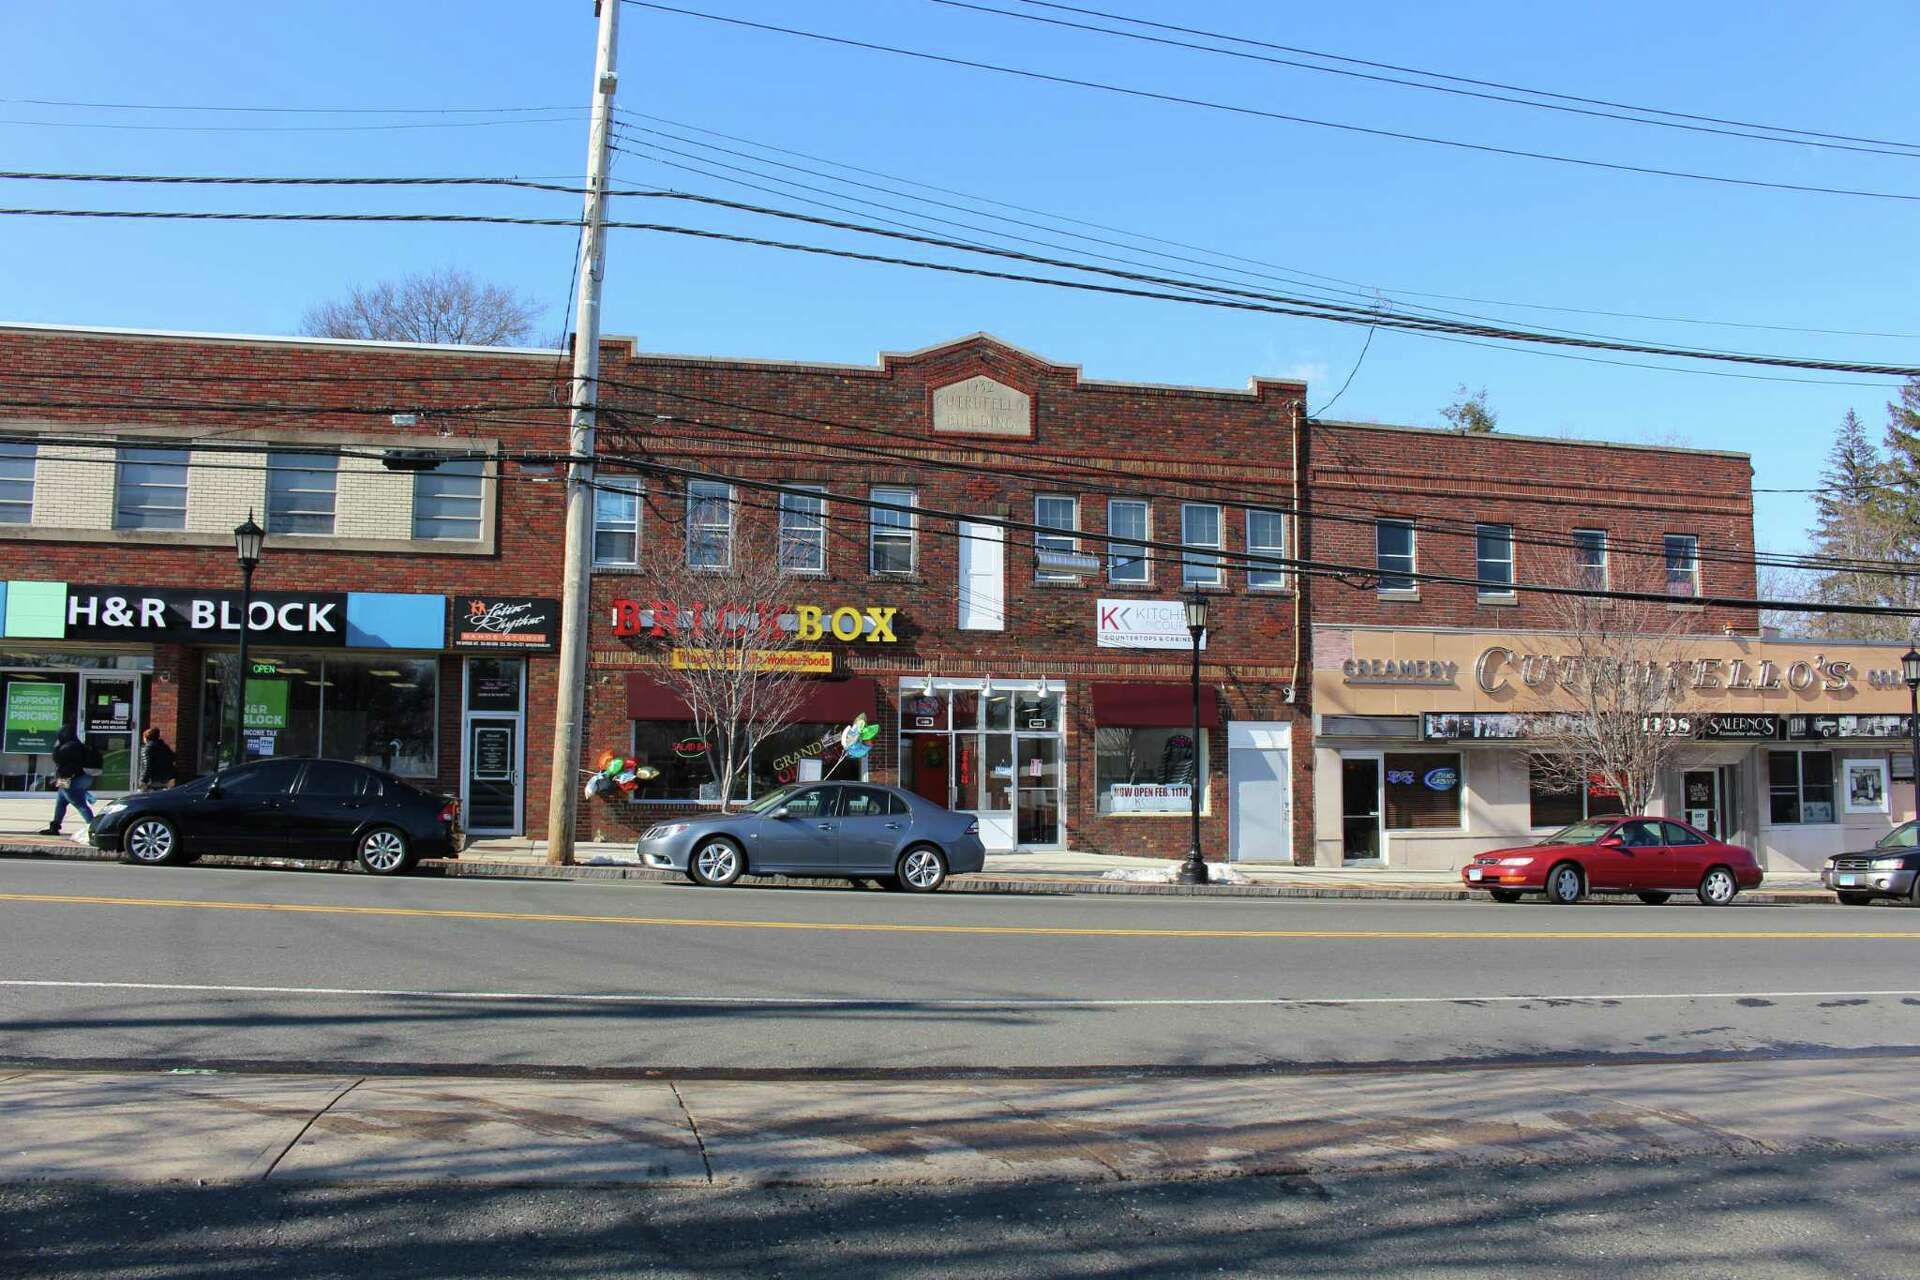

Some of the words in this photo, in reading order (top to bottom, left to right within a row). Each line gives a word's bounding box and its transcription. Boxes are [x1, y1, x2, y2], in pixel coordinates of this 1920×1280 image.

[68, 596, 166, 628] H&R
[191, 599, 336, 632] BLOCK
[487, 602, 532, 617] Latin
[612, 599, 787, 640] BRICK
[796, 606, 897, 643] BOX
[253, 664, 276, 674] OPEN
[1343, 658, 1458, 680] CREAMERY
[11, 695, 60, 705] UPFRONT
[10, 711, 58, 721] PRICING
[1708, 717, 1774, 735] SALERNO'S
[773, 741, 823, 772] GRAND
[1134, 787, 1153, 798] OPEN
[1154, 788, 1170, 798] FEB.
[1171, 788, 1189, 798] 11TH
